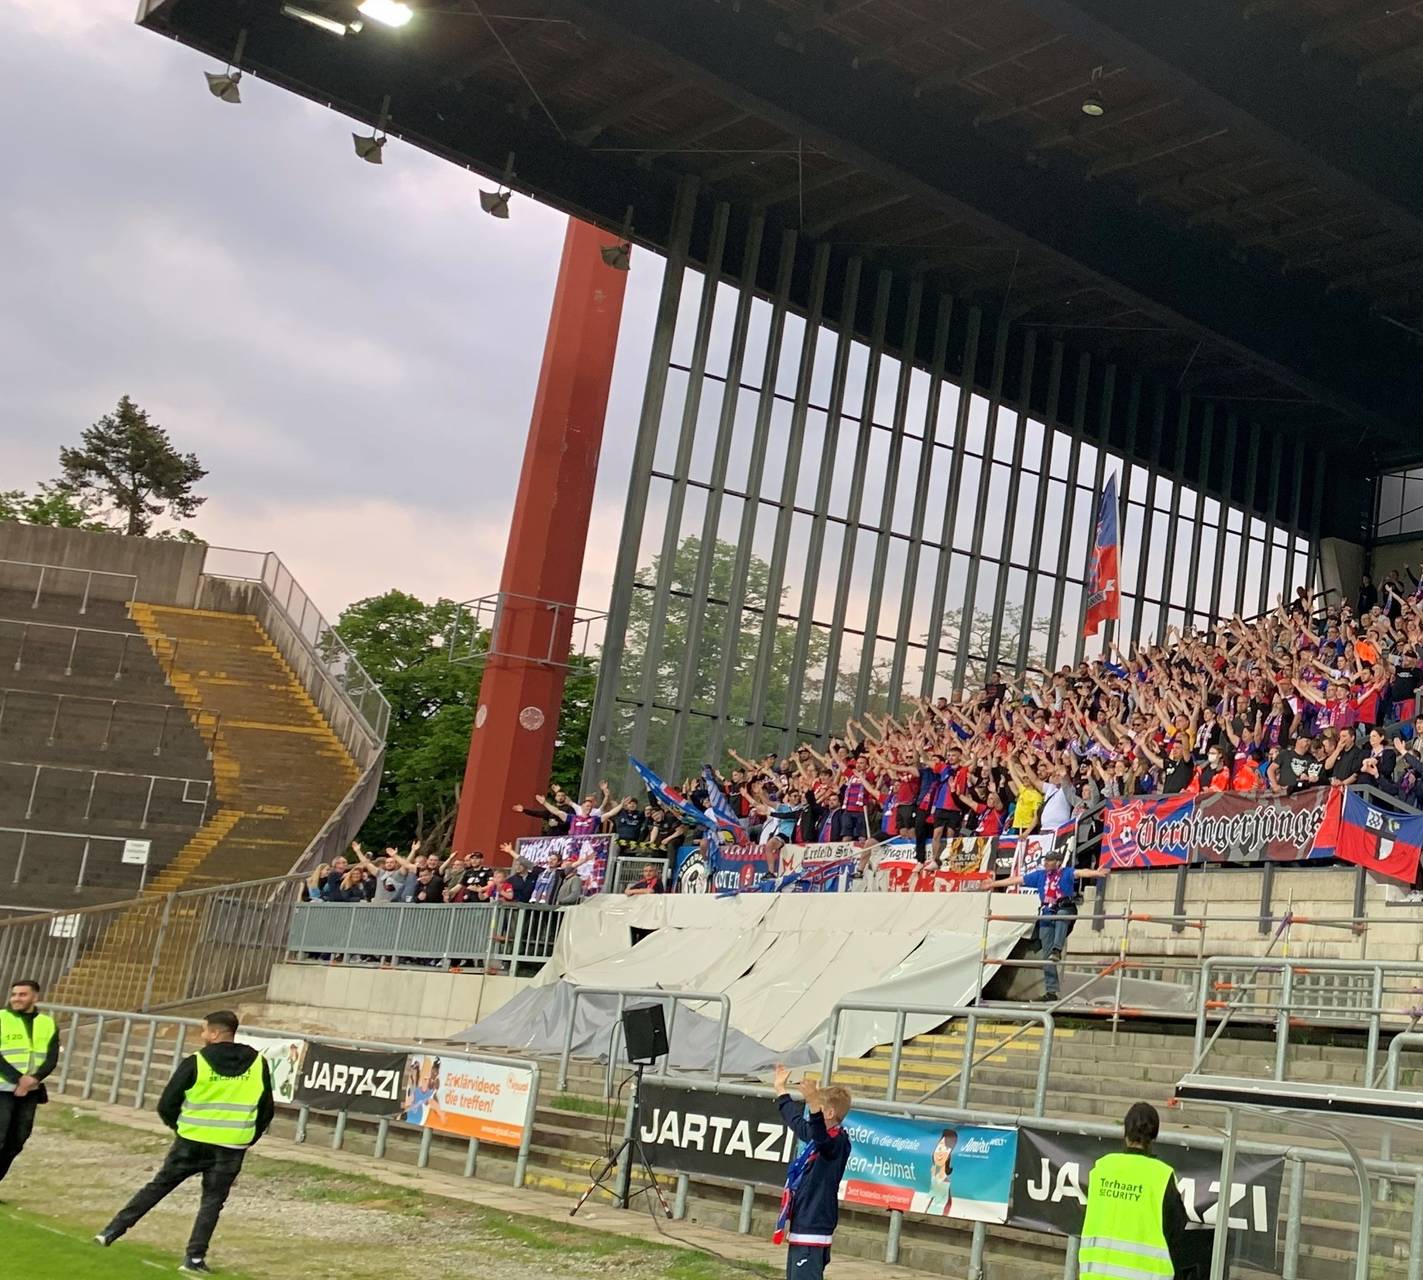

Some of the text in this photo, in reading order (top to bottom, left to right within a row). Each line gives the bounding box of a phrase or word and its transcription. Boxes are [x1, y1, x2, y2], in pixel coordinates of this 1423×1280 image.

[303, 1061, 400, 1100] JARTAZI
[444, 1072, 501, 1096] Erklärvideos
[444, 1090, 495, 1113] die treffen!
[640, 1108, 795, 1163] JARTAZI
[1027, 1158, 1268, 1232] JAAZI
[1100, 1178, 1143, 1193] Terhaart
